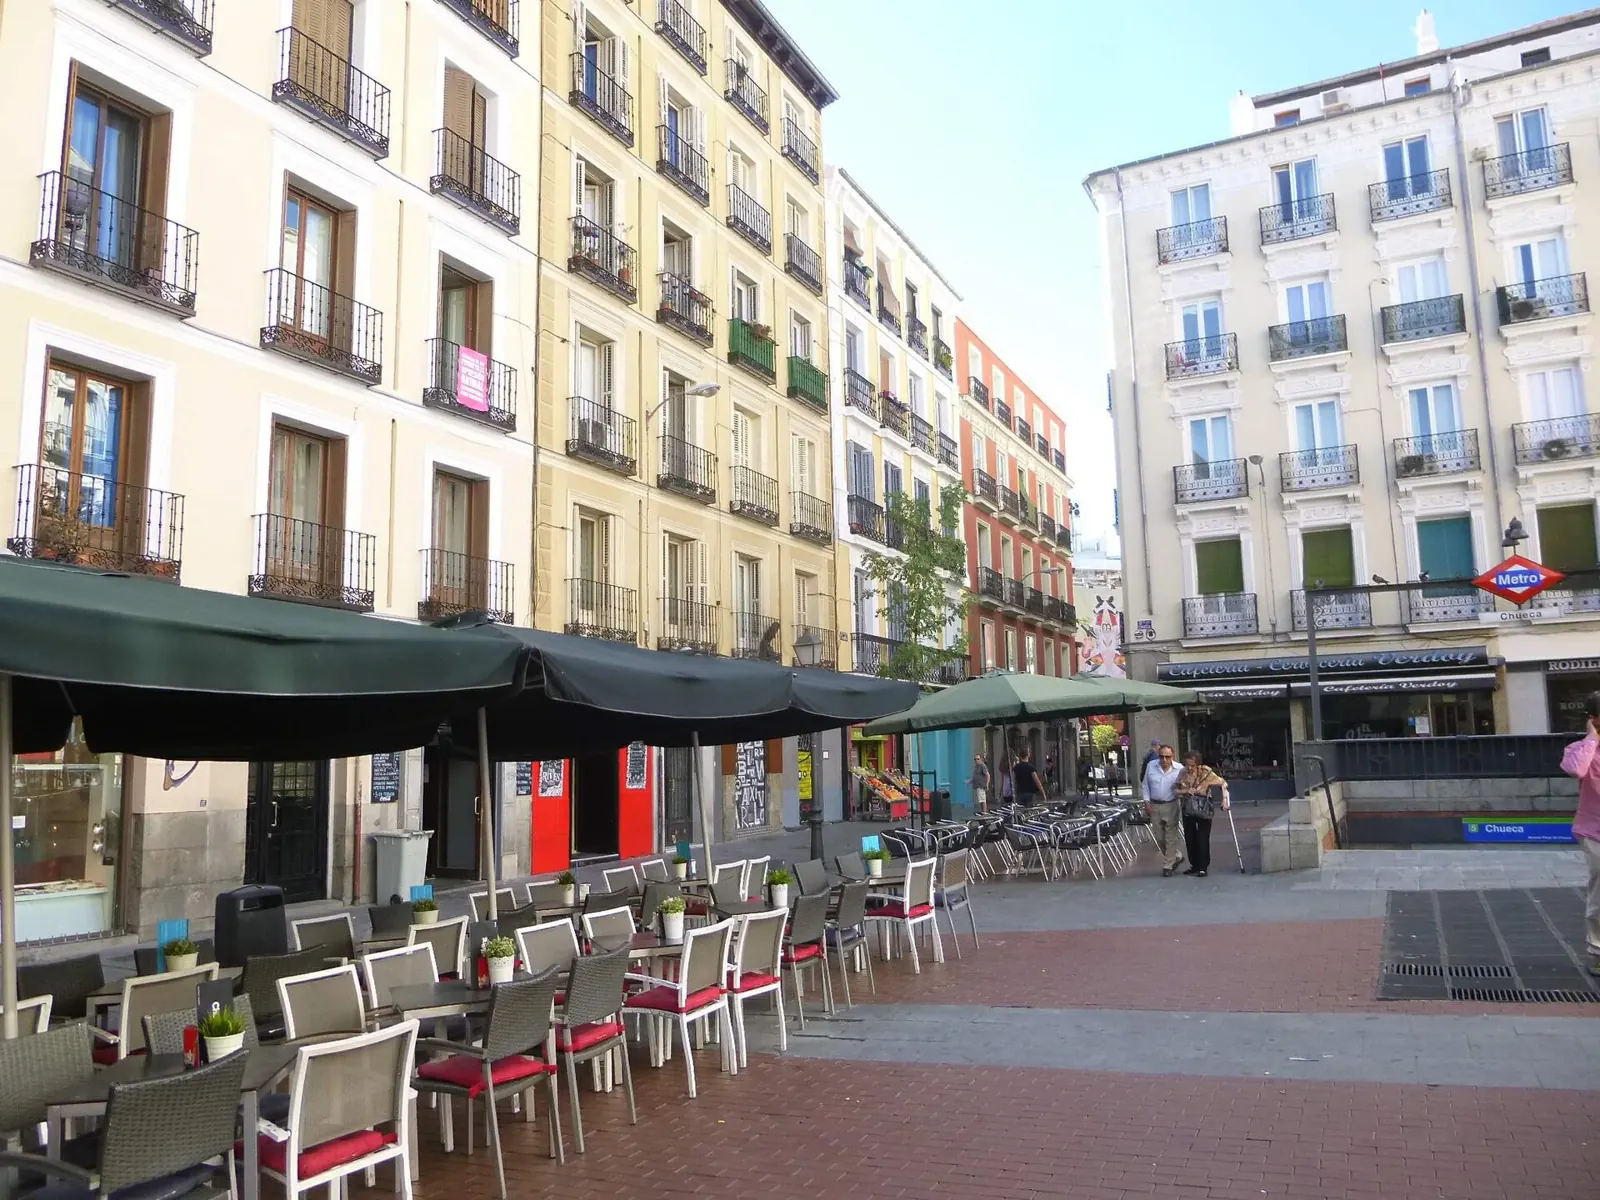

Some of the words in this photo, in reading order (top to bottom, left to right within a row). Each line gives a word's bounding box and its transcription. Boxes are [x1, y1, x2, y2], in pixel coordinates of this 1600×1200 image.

[1498, 574, 1538, 585] Metro
[1500, 612, 1542, 621] Chueca
[1372, 650, 1477, 665] Verdoy
[1548, 660, 1600, 671] RODIL
[1399, 680, 1458, 689] Verdoy
[1228, 689, 1280, 697] Verdoy
[1485, 824, 1524, 833] Chueca
